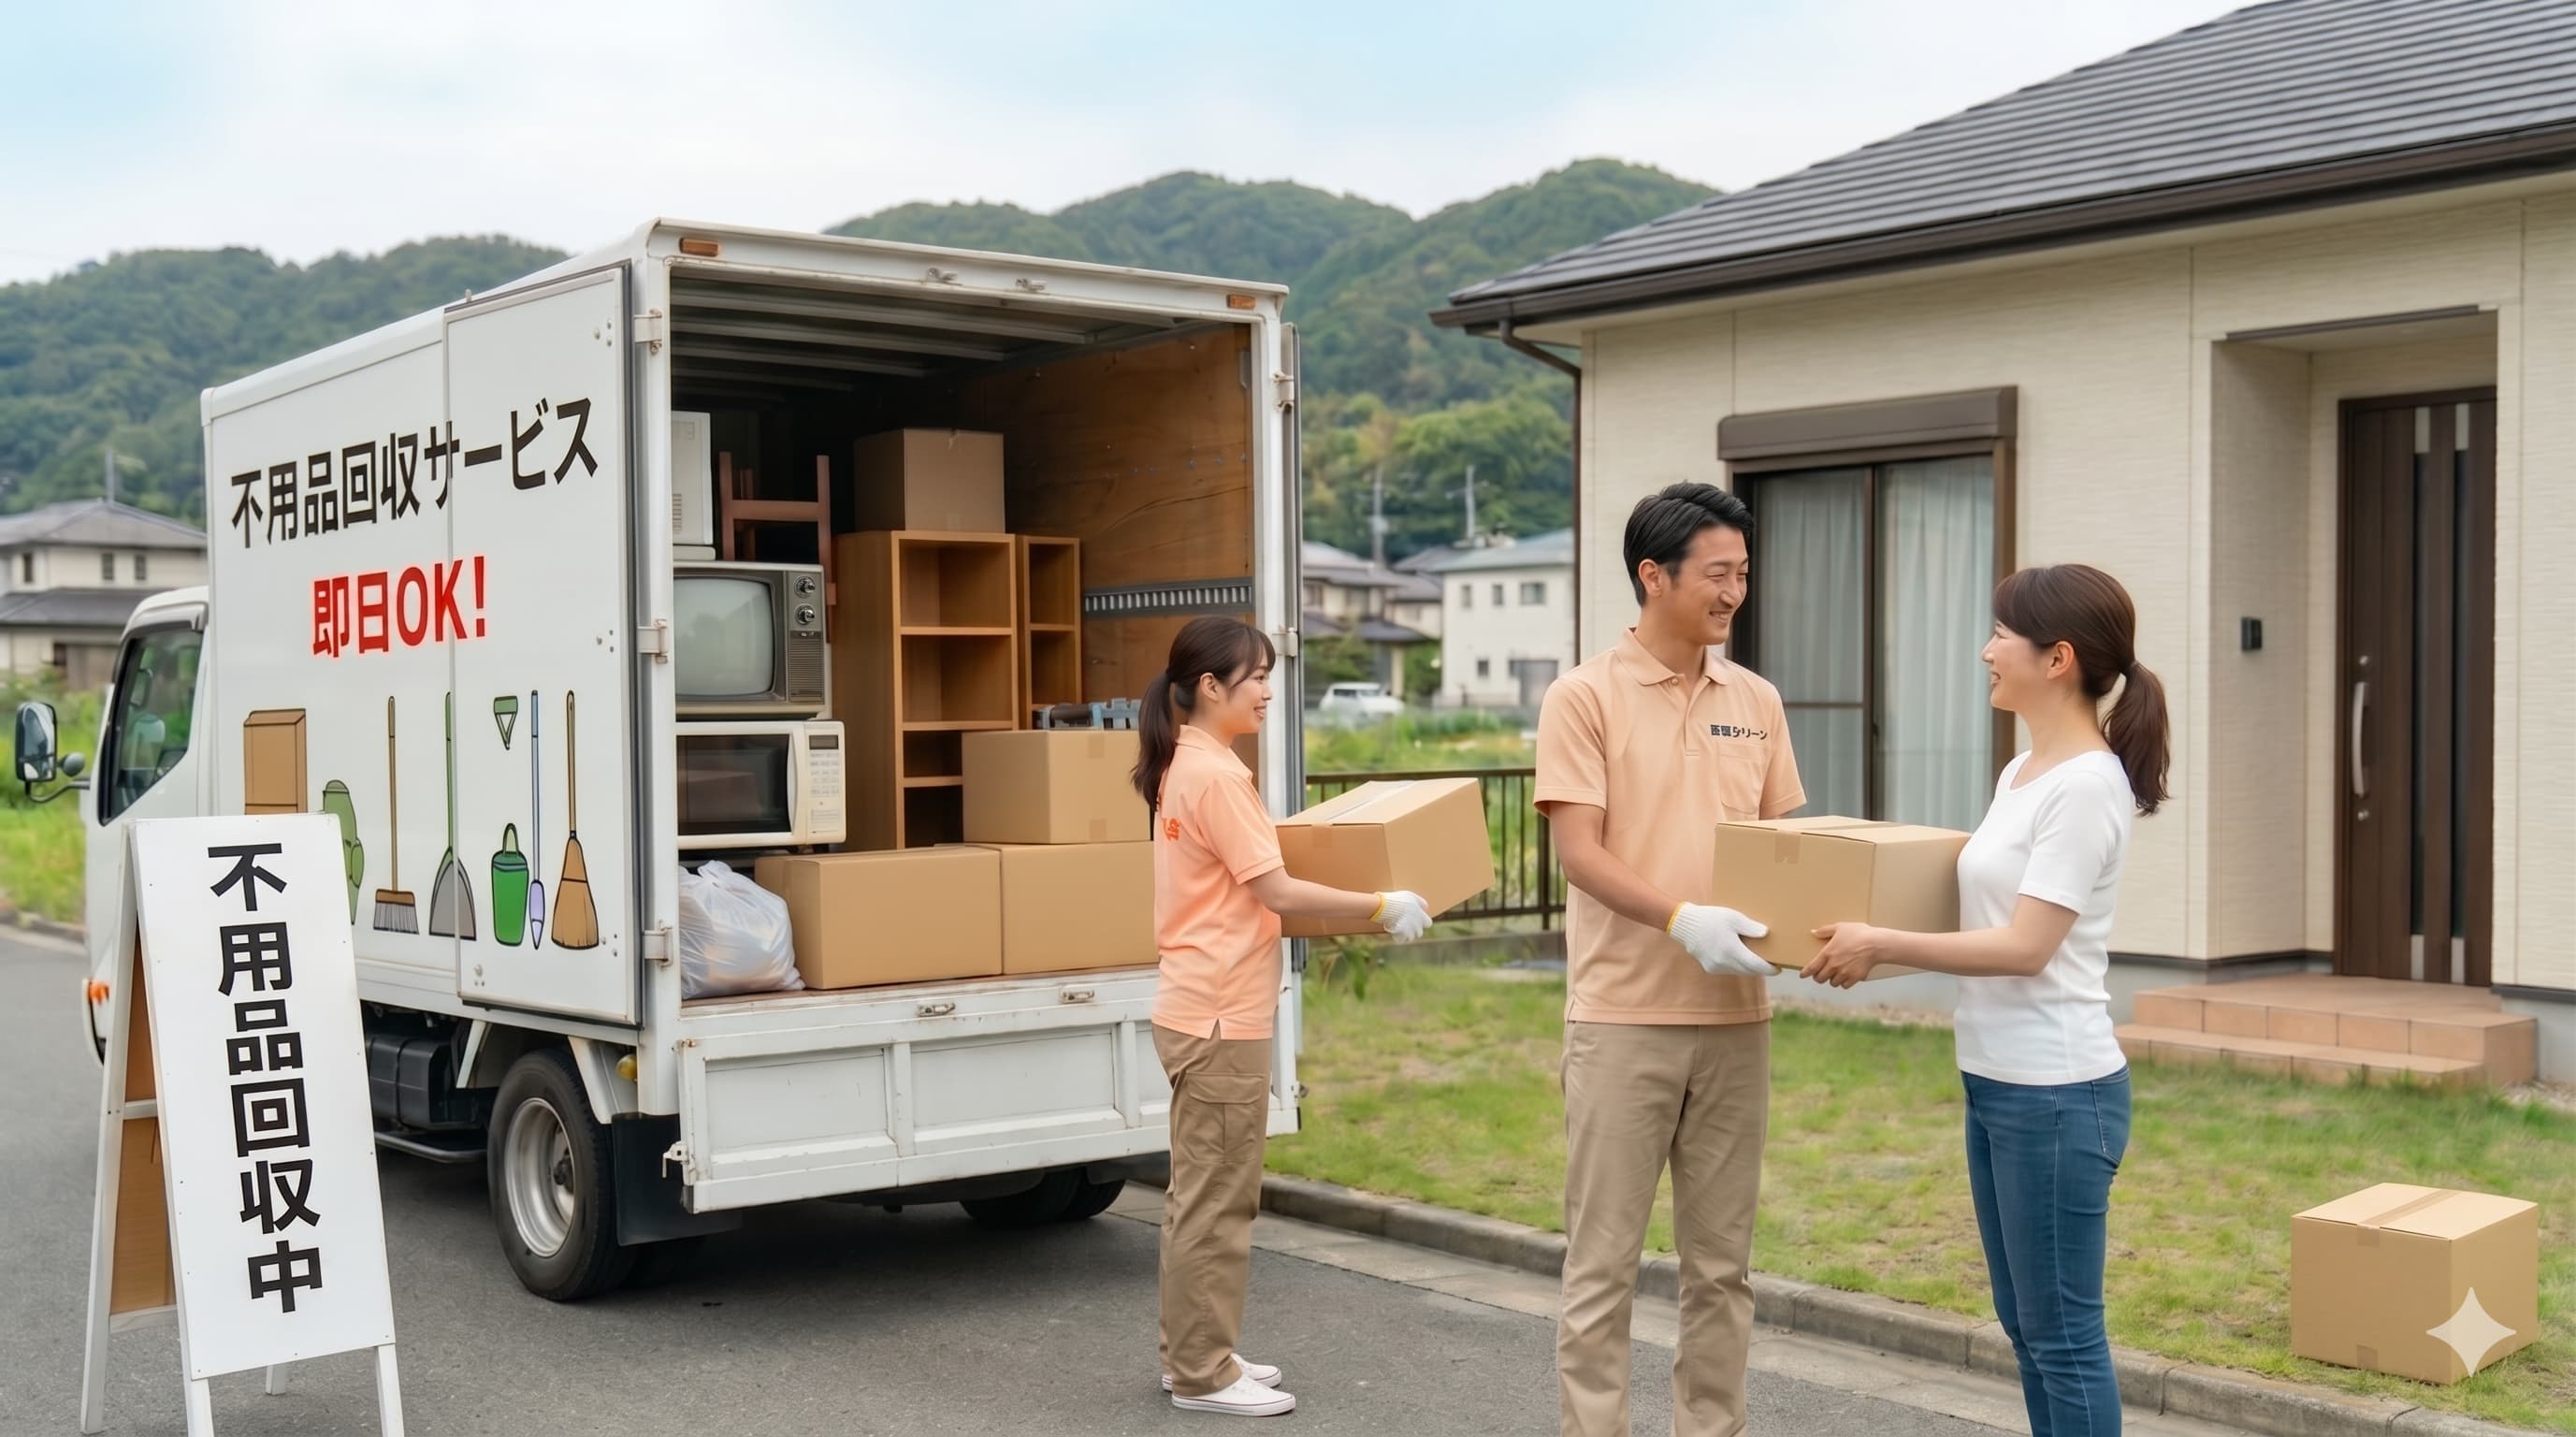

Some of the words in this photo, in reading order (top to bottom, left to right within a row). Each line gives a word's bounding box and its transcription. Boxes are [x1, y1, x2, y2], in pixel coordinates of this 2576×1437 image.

[231, 398, 599, 548] 不用品回収サービス
[312, 556, 485, 658] 即日OK!
[208, 843, 323, 1314] 不用品回収中
